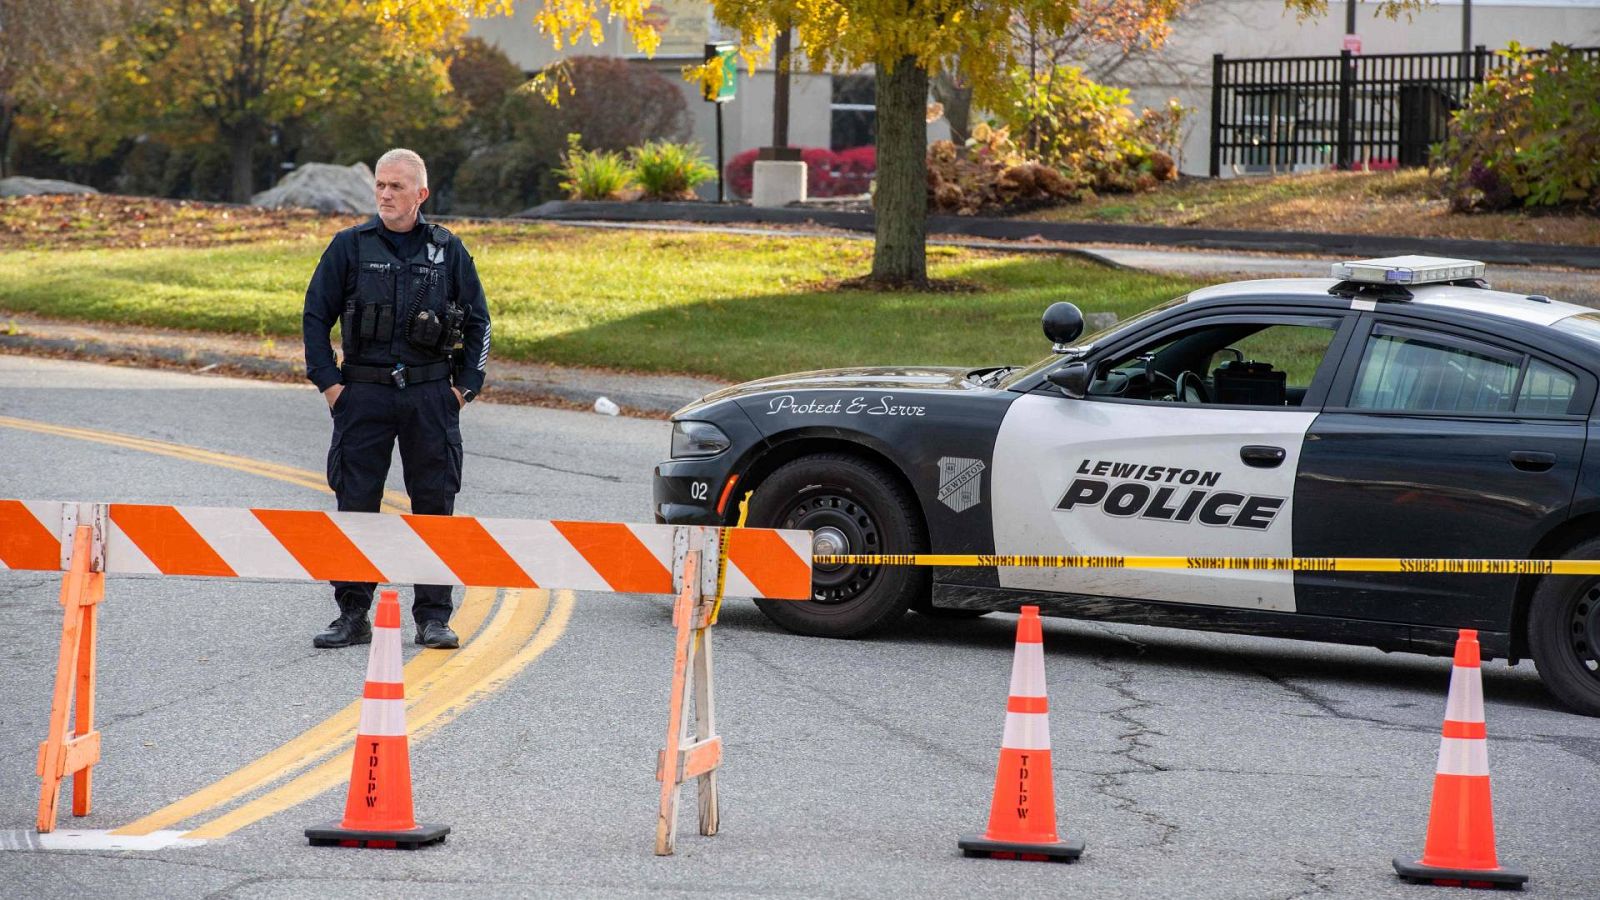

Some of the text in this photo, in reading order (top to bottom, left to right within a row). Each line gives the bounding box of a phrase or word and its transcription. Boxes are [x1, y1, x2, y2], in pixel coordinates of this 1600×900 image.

[766, 395, 926, 416] Protect & Serve
[940, 462, 983, 497] LEWISTON
[1076, 459, 1222, 487] LEWISTON
[691, 481, 708, 500] 02
[1052, 476, 1289, 531] POLICE
[978, 556, 1125, 568] POLICE LINE DO NOT CROSS
[1187, 557, 1336, 571] POLICE LINE DO NOT CROSS
[1400, 559, 1552, 573] POLICE LINE DO NOT CROSS
